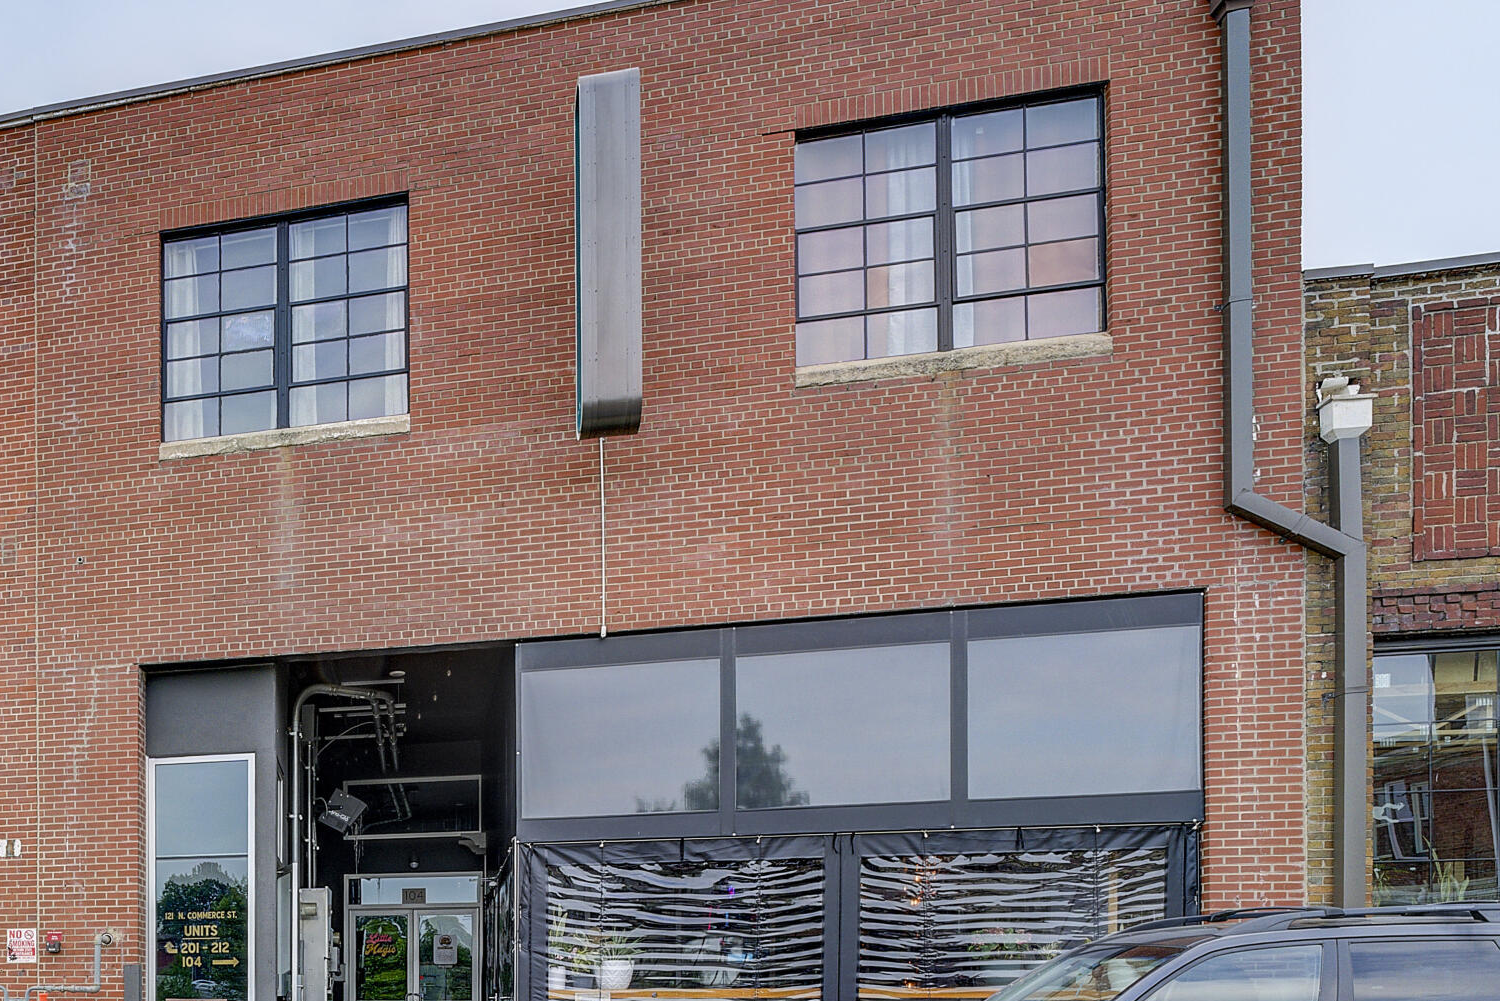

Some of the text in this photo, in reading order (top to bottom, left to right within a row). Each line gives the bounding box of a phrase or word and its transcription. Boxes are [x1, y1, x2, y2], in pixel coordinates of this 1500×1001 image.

[404, 890, 425, 901] 104
[164, 910, 238, 920] 121 N. COMMERCE ST.
[8, 929, 23, 939] NO
[183, 924, 218, 937] UNITS
[181, 942, 200, 954] 201
[211, 941, 230, 953] 212
[364, 943, 397, 957] Magic
[182, 955, 203, 968] 104
